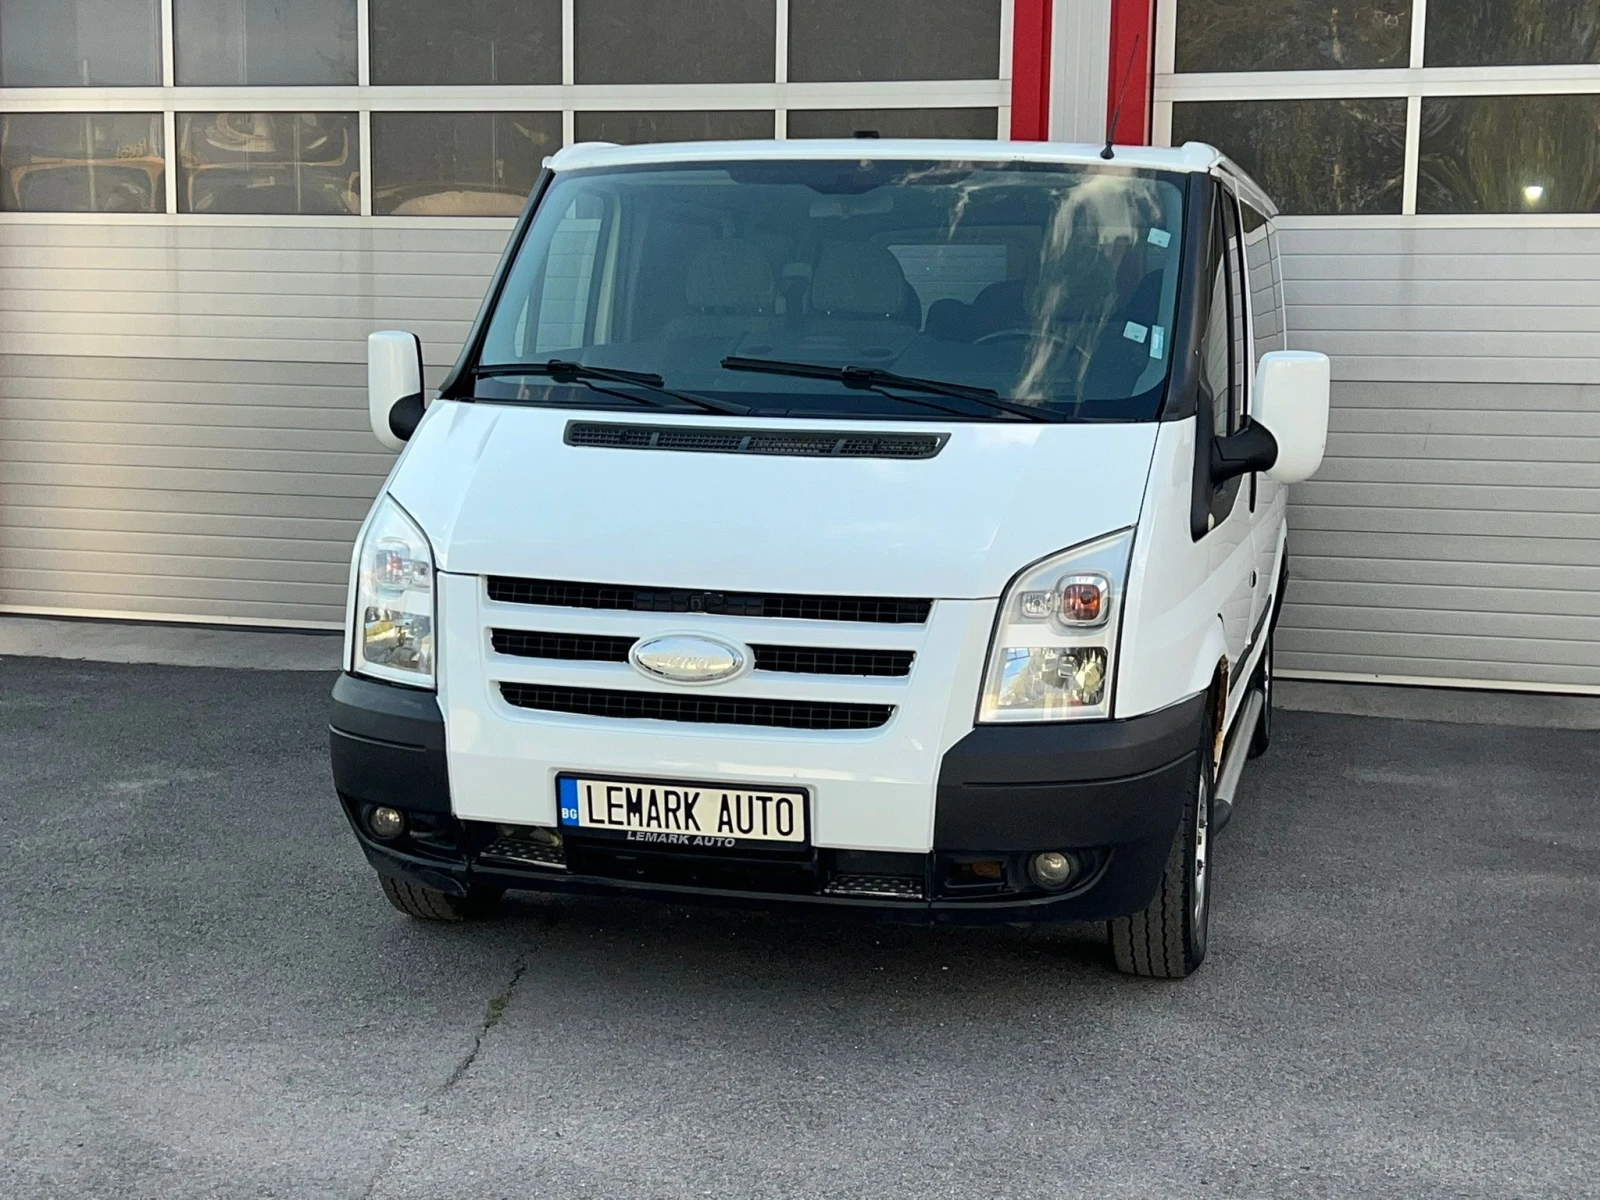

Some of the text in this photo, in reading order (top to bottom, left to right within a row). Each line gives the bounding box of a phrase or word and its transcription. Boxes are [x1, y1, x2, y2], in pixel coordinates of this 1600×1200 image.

[561, 807, 578, 820] BG
[586, 784, 794, 837] LEMARK AUTO
[626, 830, 736, 848] LEMARK AUTO
